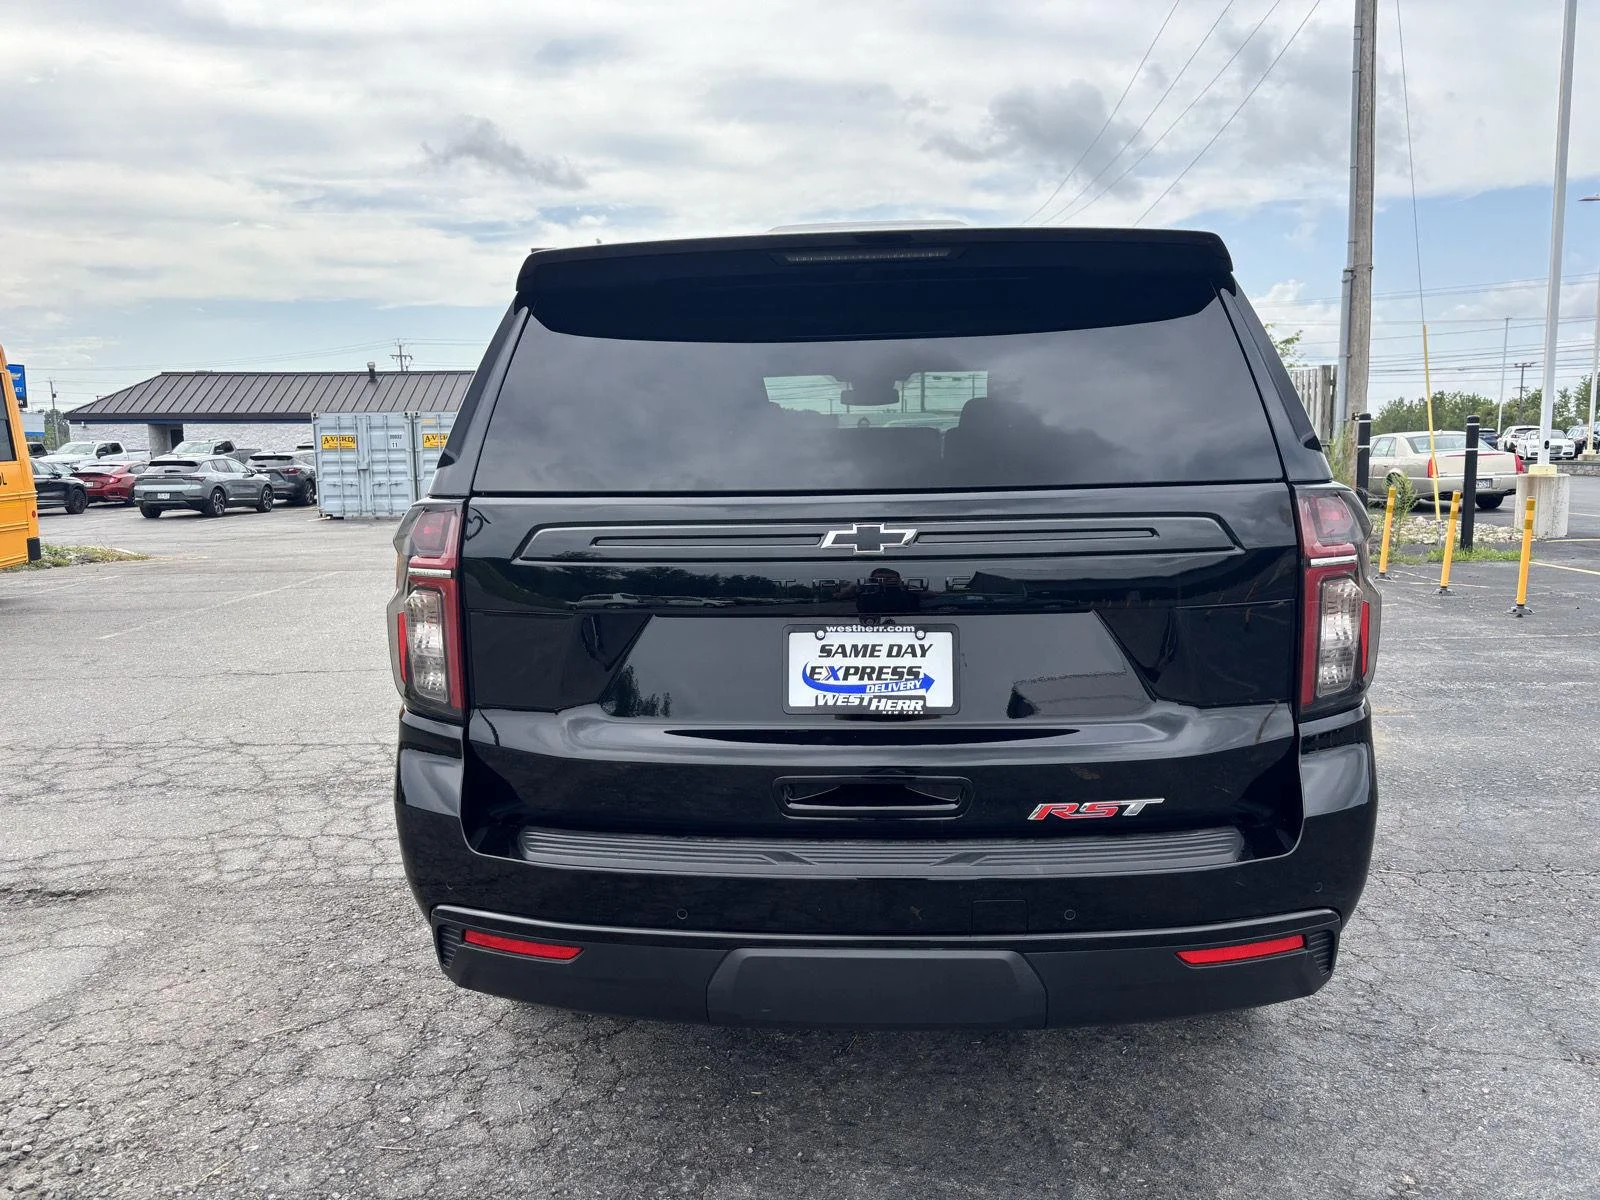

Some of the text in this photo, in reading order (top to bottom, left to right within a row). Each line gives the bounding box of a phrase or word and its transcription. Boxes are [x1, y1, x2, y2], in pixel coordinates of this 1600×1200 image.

[825, 624, 916, 633] westherr.com
[818, 643, 934, 658] SAME DAY
[809, 665, 922, 682] EXPRESS
[865, 679, 924, 694] DELIVERY
[1027, 797, 1166, 821] RST
